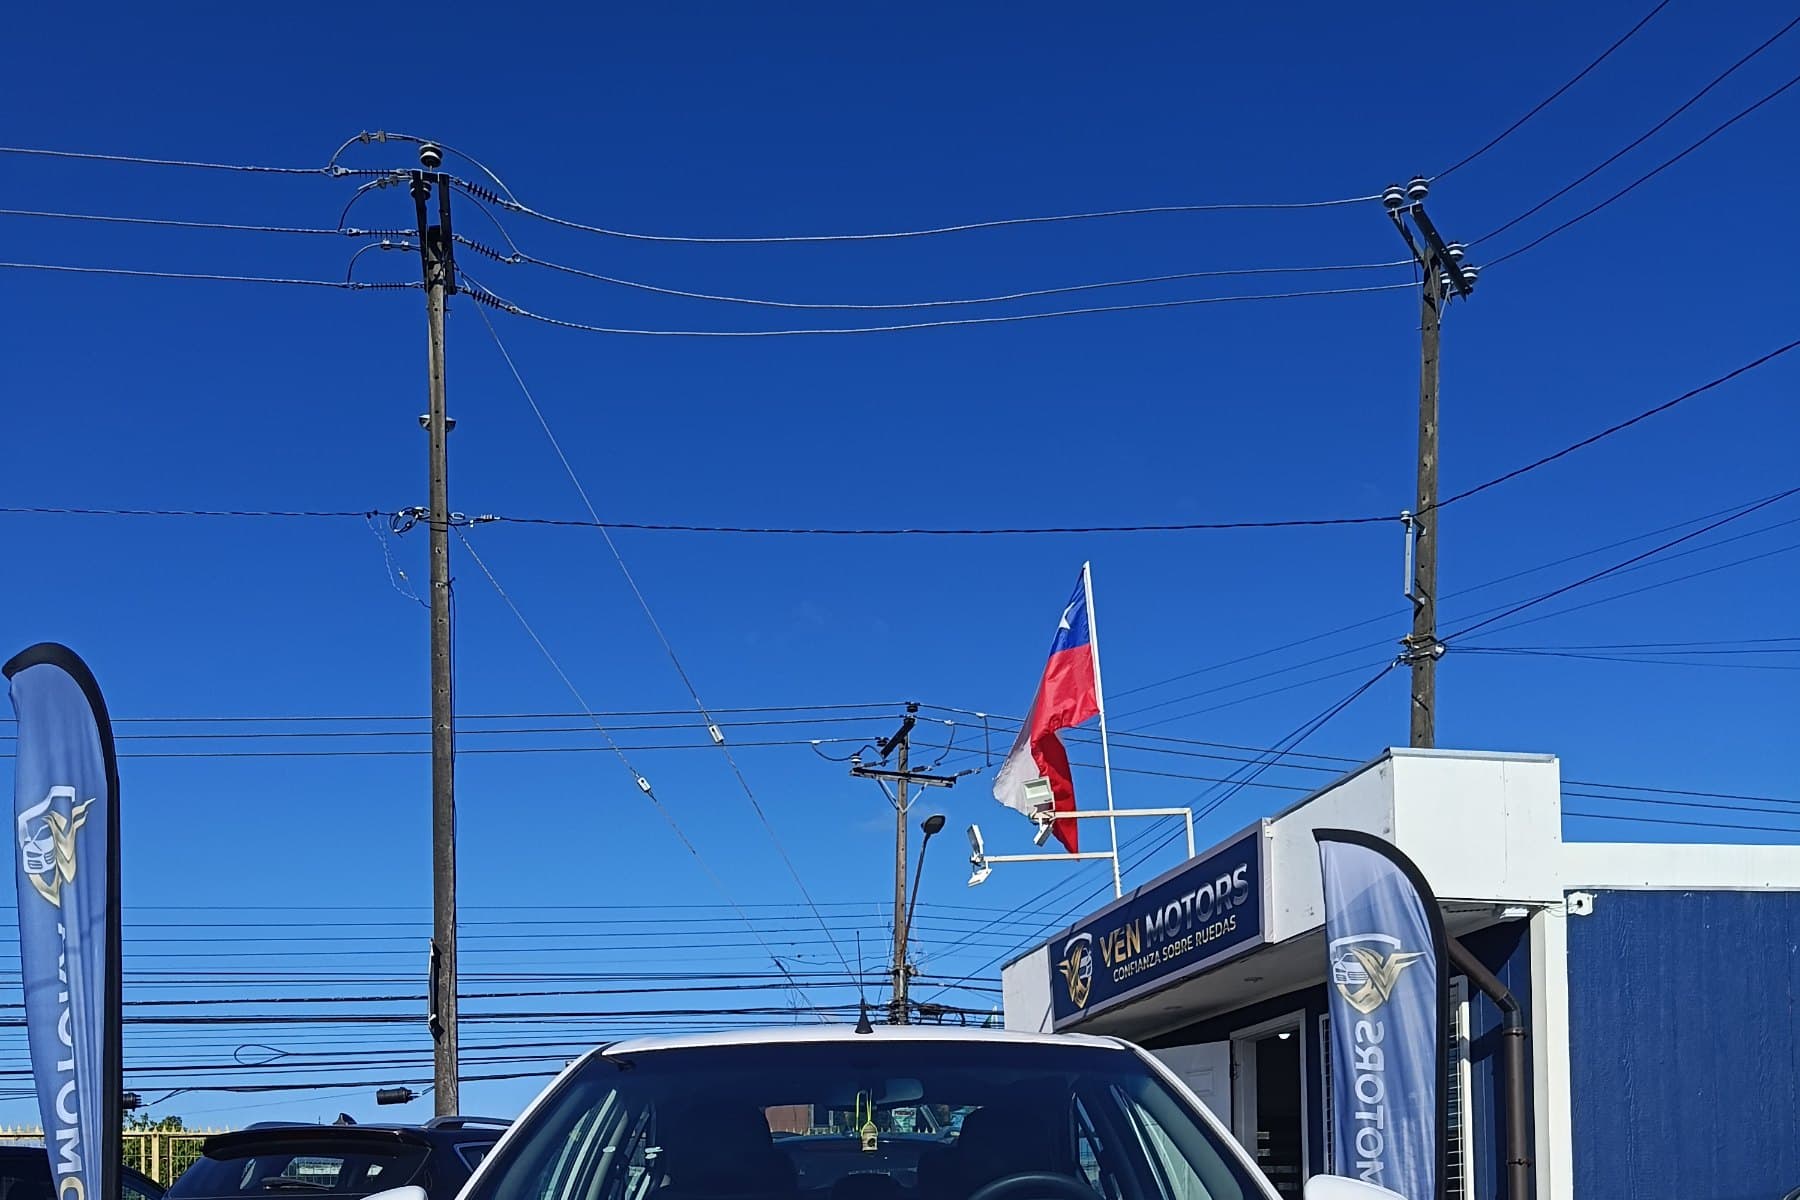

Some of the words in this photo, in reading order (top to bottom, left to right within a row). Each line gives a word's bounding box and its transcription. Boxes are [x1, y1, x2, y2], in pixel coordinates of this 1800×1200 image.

[1099, 918, 1141, 968] VEN
[1145, 863, 1249, 948] MOTORS
[1113, 951, 1162, 984] CONFIANZA
[1162, 937, 1194, 964] SOBRE
[1195, 914, 1237, 947] RUEDAS
